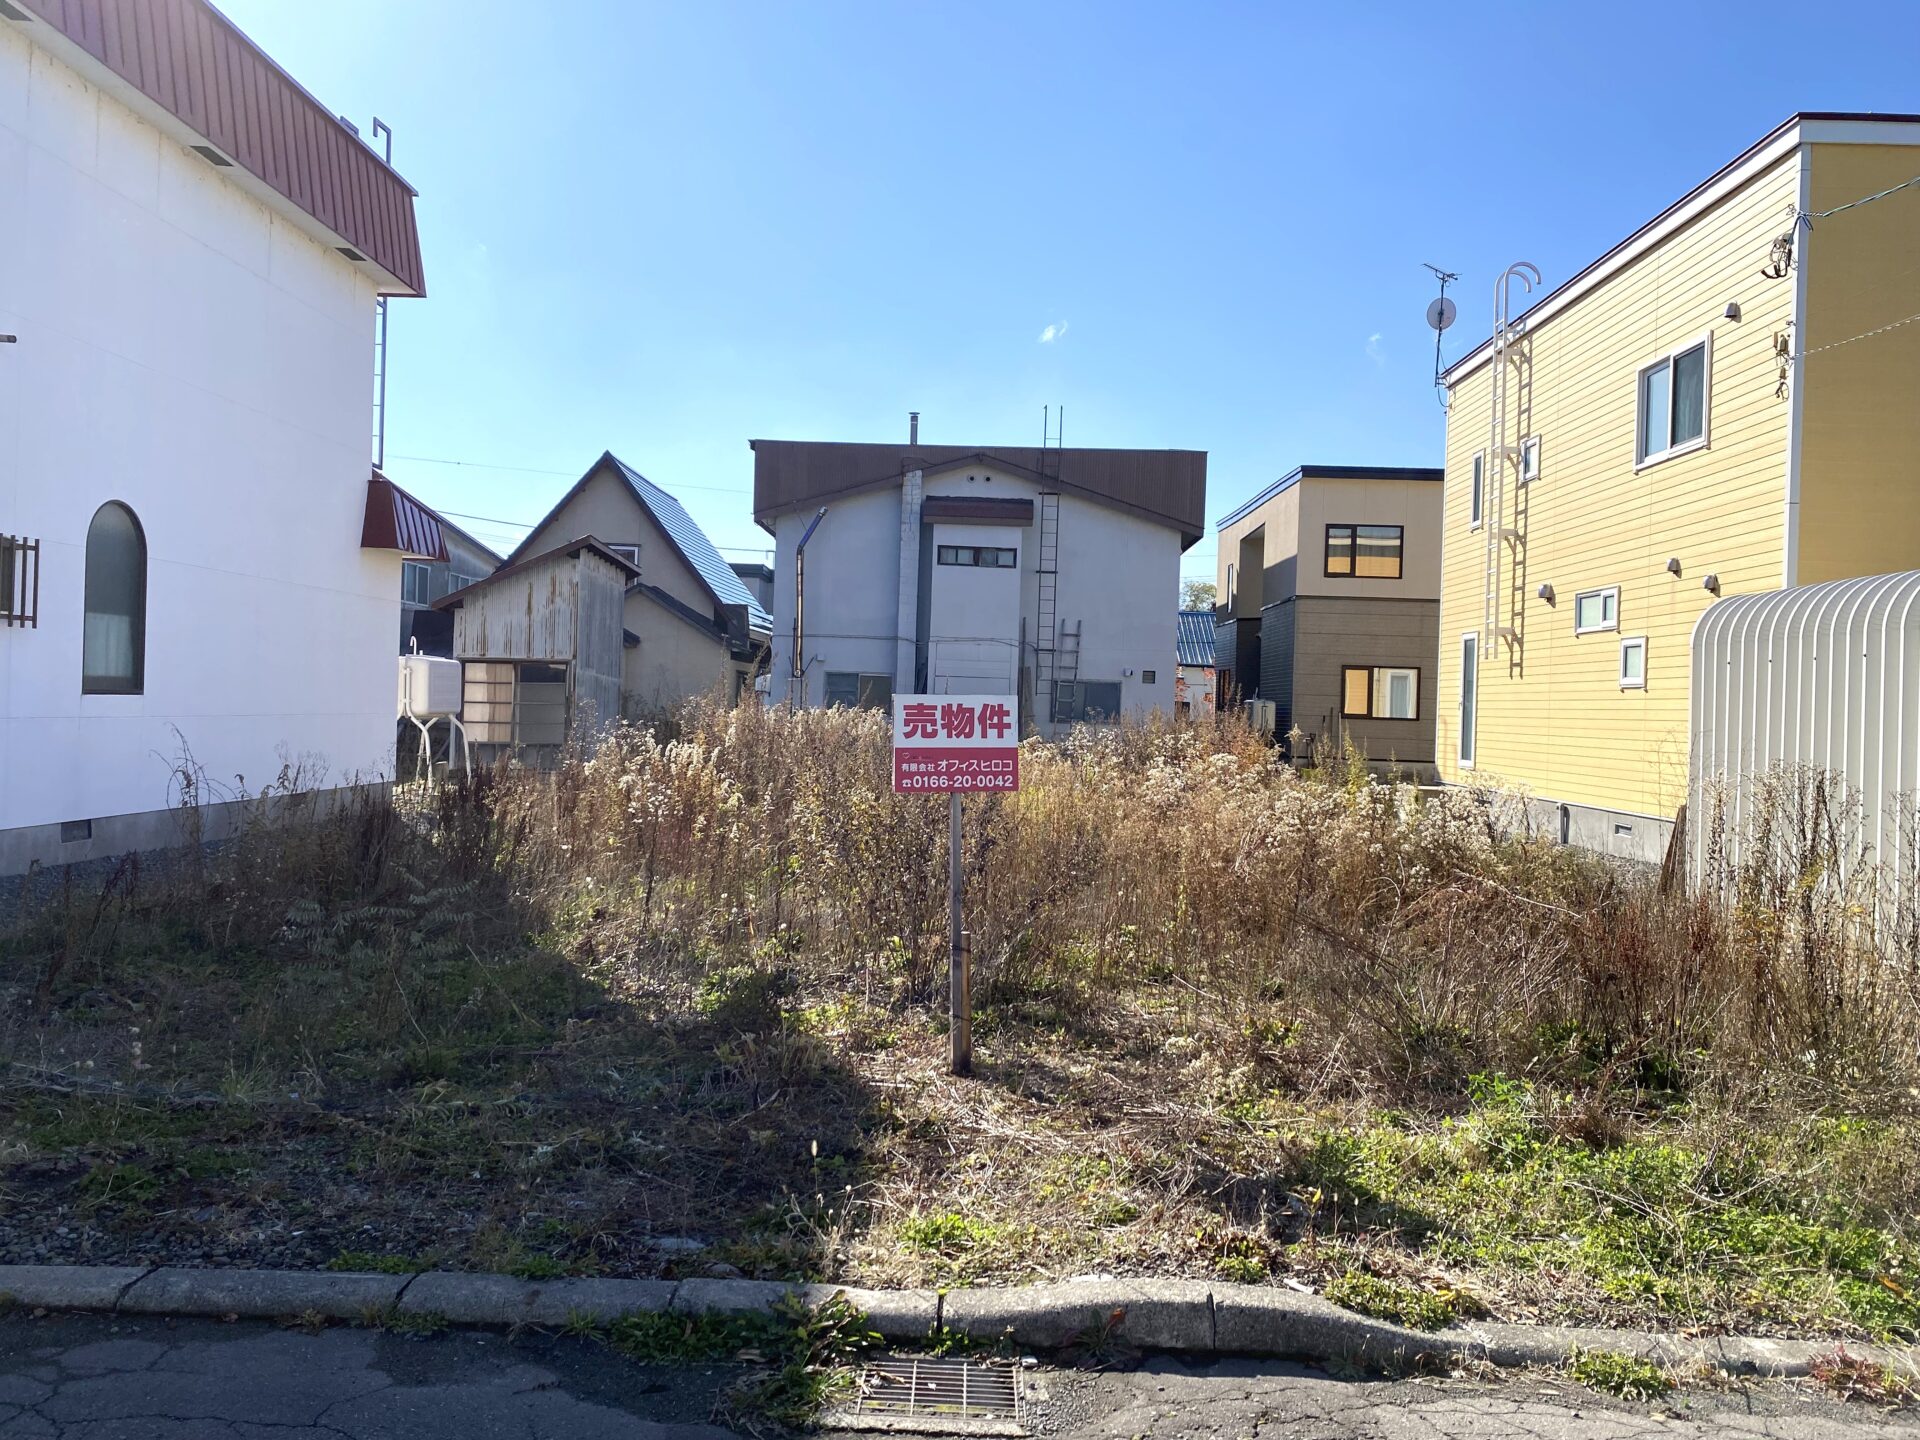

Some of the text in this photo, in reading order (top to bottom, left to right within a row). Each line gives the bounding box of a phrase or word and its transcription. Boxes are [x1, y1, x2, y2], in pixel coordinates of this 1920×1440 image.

[902, 702, 1012, 739] 売物件
[901, 759, 1013, 772] 有限会社 オフィスヒロコ
[913, 775, 1014, 788] 0166-20-0042
